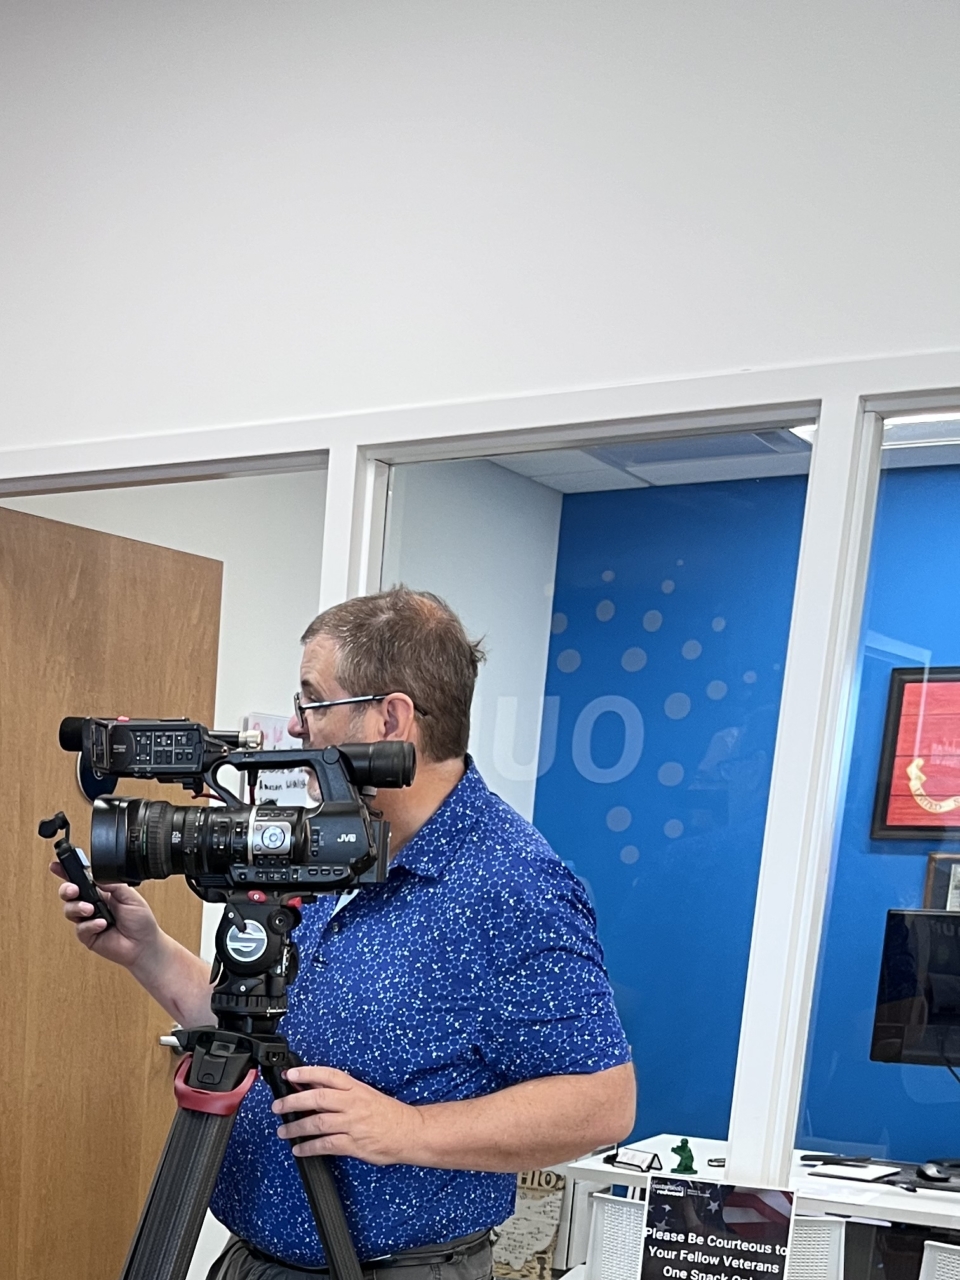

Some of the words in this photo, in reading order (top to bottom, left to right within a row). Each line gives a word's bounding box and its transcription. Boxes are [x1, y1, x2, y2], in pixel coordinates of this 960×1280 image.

[644, 1227, 685, 1243] Please
[688, 1232, 704, 1245] Be
[707, 1235, 772, 1254] Courteous
[775, 1244, 788, 1256] to
[648, 1246, 677, 1259] Your
[680, 1250, 720, 1265] Fellow
[723, 1255, 779, 1274] Veterans
[663, 1265, 688, 1279] One
